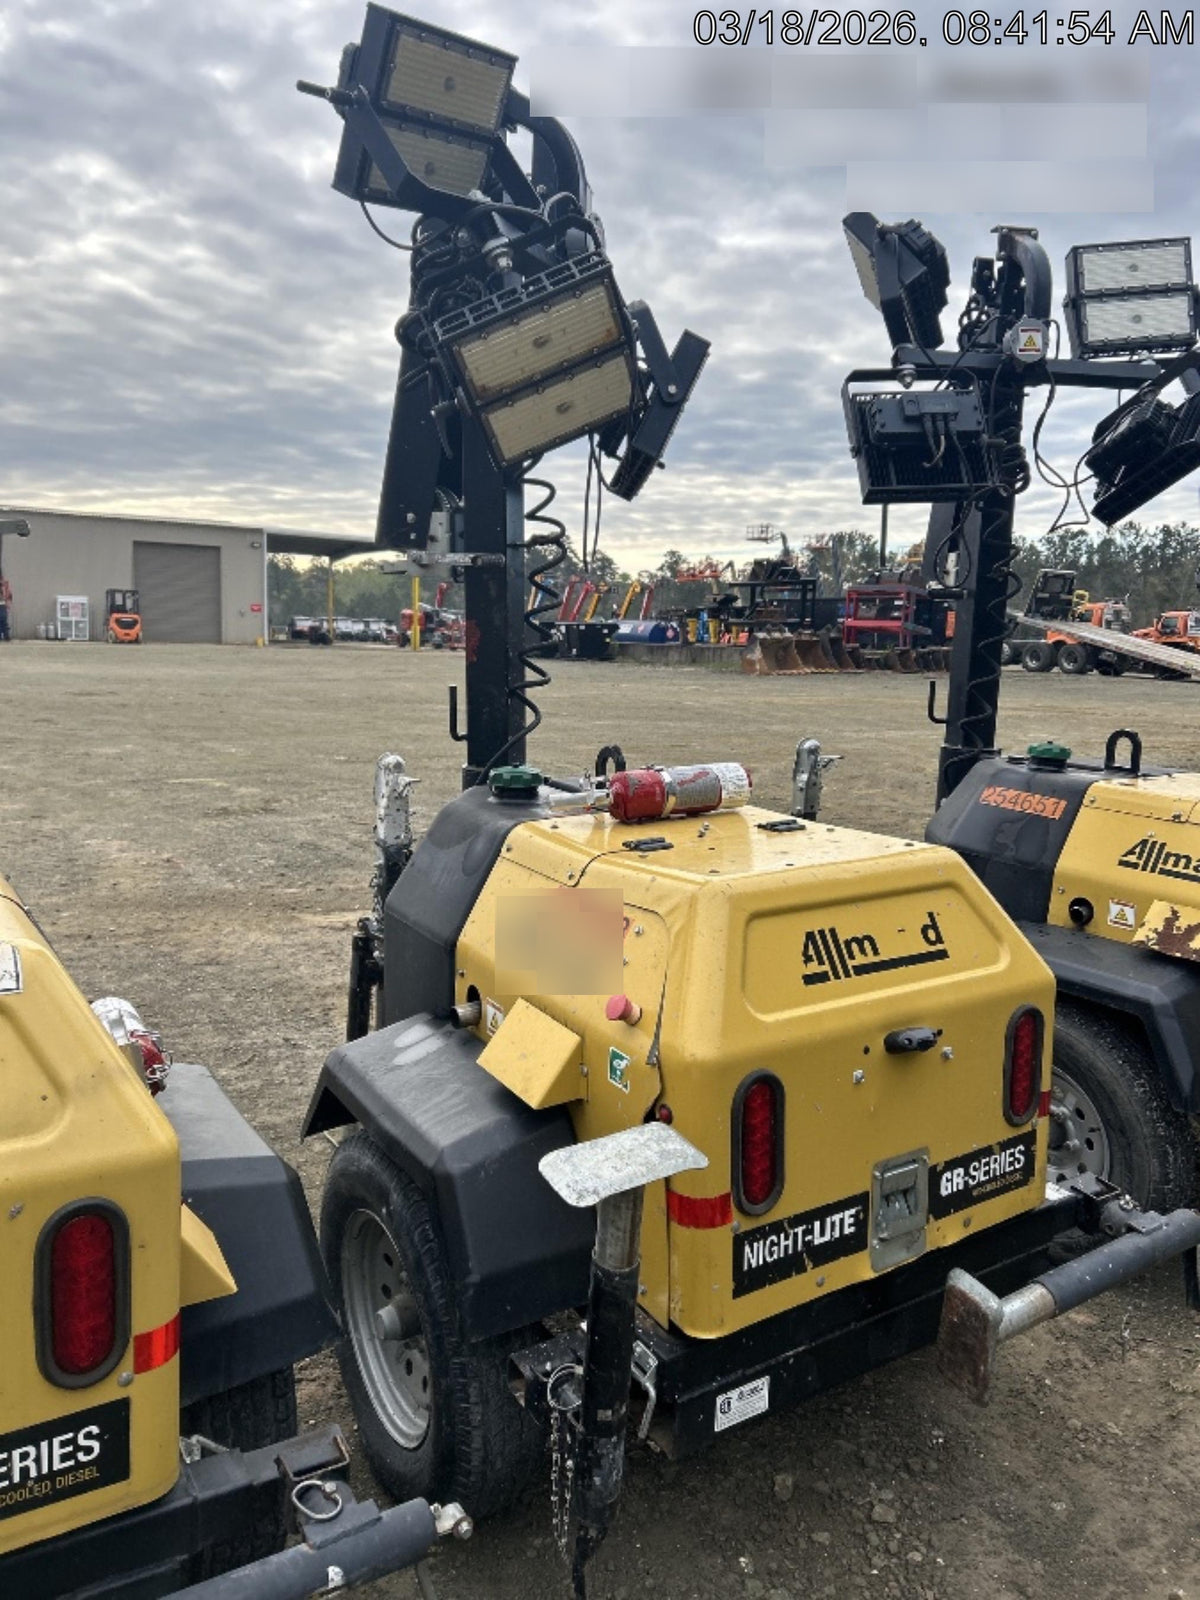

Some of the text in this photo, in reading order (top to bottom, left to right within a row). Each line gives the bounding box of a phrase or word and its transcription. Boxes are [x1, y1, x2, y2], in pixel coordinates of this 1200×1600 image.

[802, 911, 946, 981] Allmd
[940, 1144, 1025, 1197] GR-SERIES
[742, 1207, 858, 1272] NIGHT-LITE
[56, 1466, 100, 1489] DIESEL
